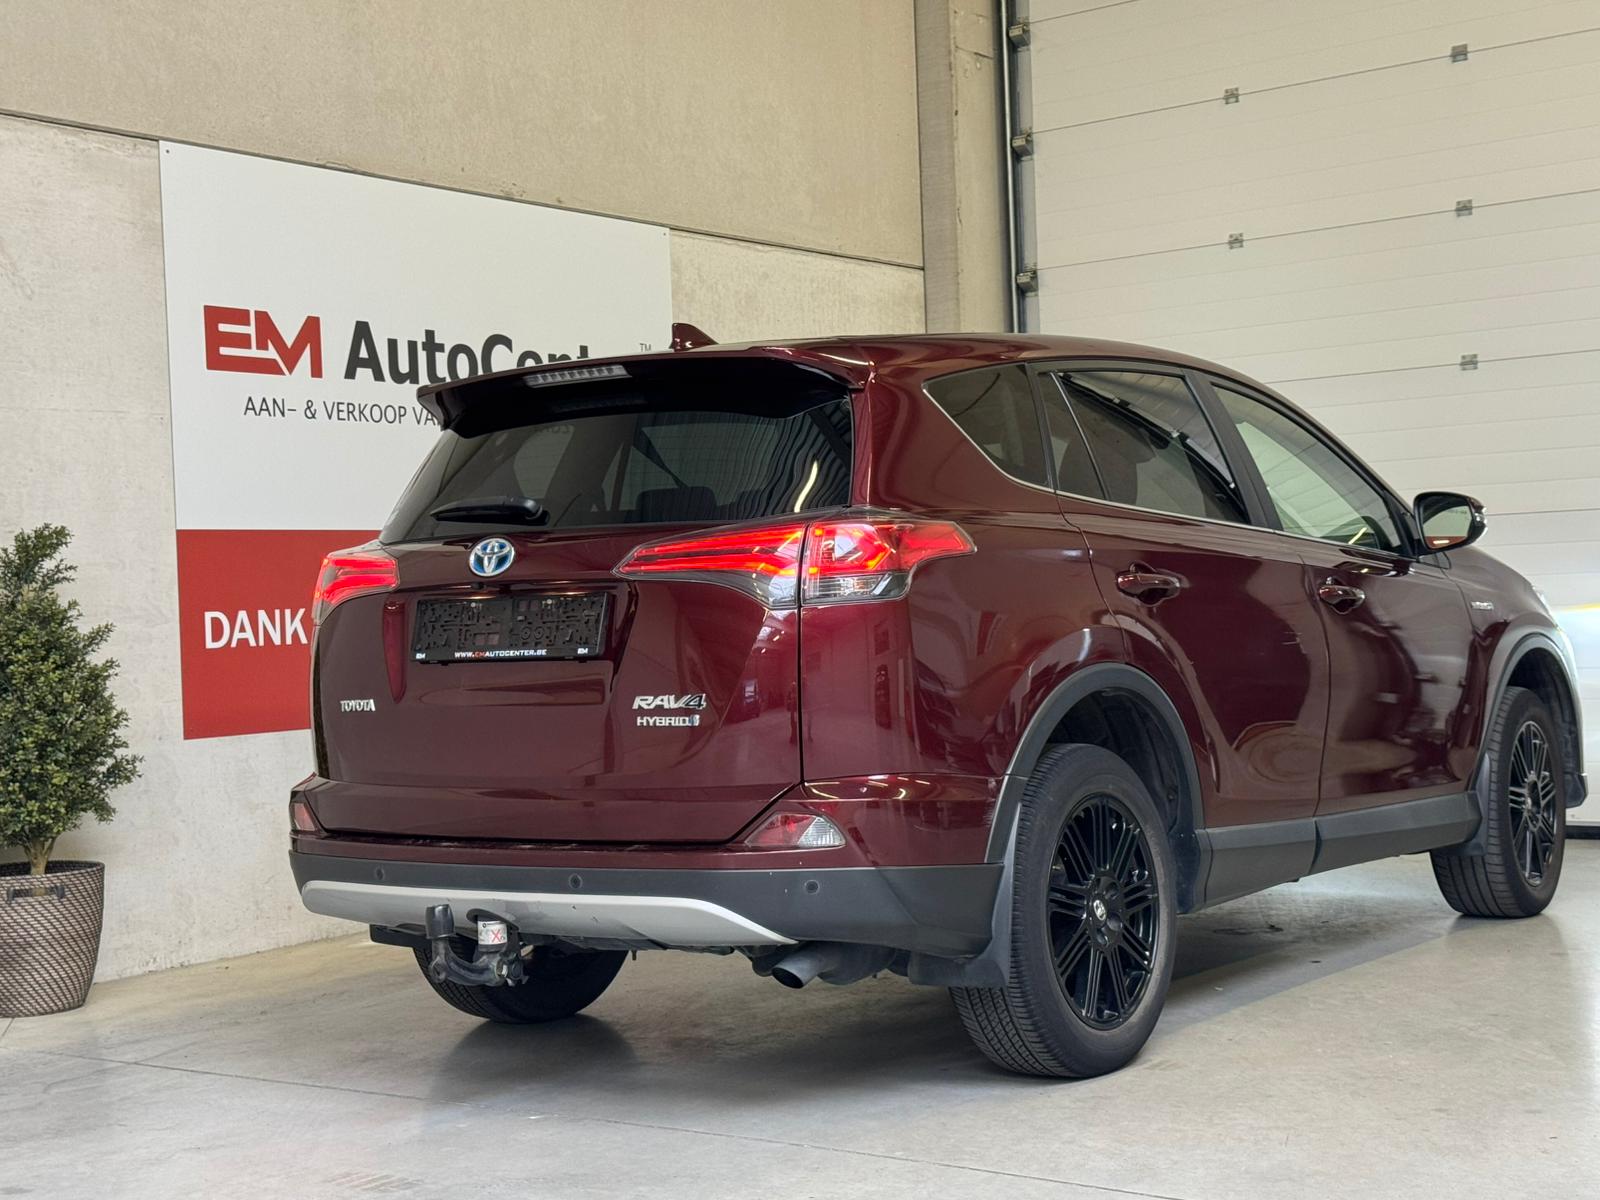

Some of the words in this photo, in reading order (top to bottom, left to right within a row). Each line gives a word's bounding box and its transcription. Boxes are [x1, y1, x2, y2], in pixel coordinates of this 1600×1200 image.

[203, 304, 323, 379] EM
[344, 320, 590, 386] AutoC
[640, 342, 652, 352] TM
[304, 399, 317, 419] &
[323, 401, 407, 424] VERKOOP
[412, 406, 441, 426] VA
[204, 608, 308, 649] DANK
[340, 699, 376, 712] TOYOTA
[632, 693, 707, 710] RAV4
